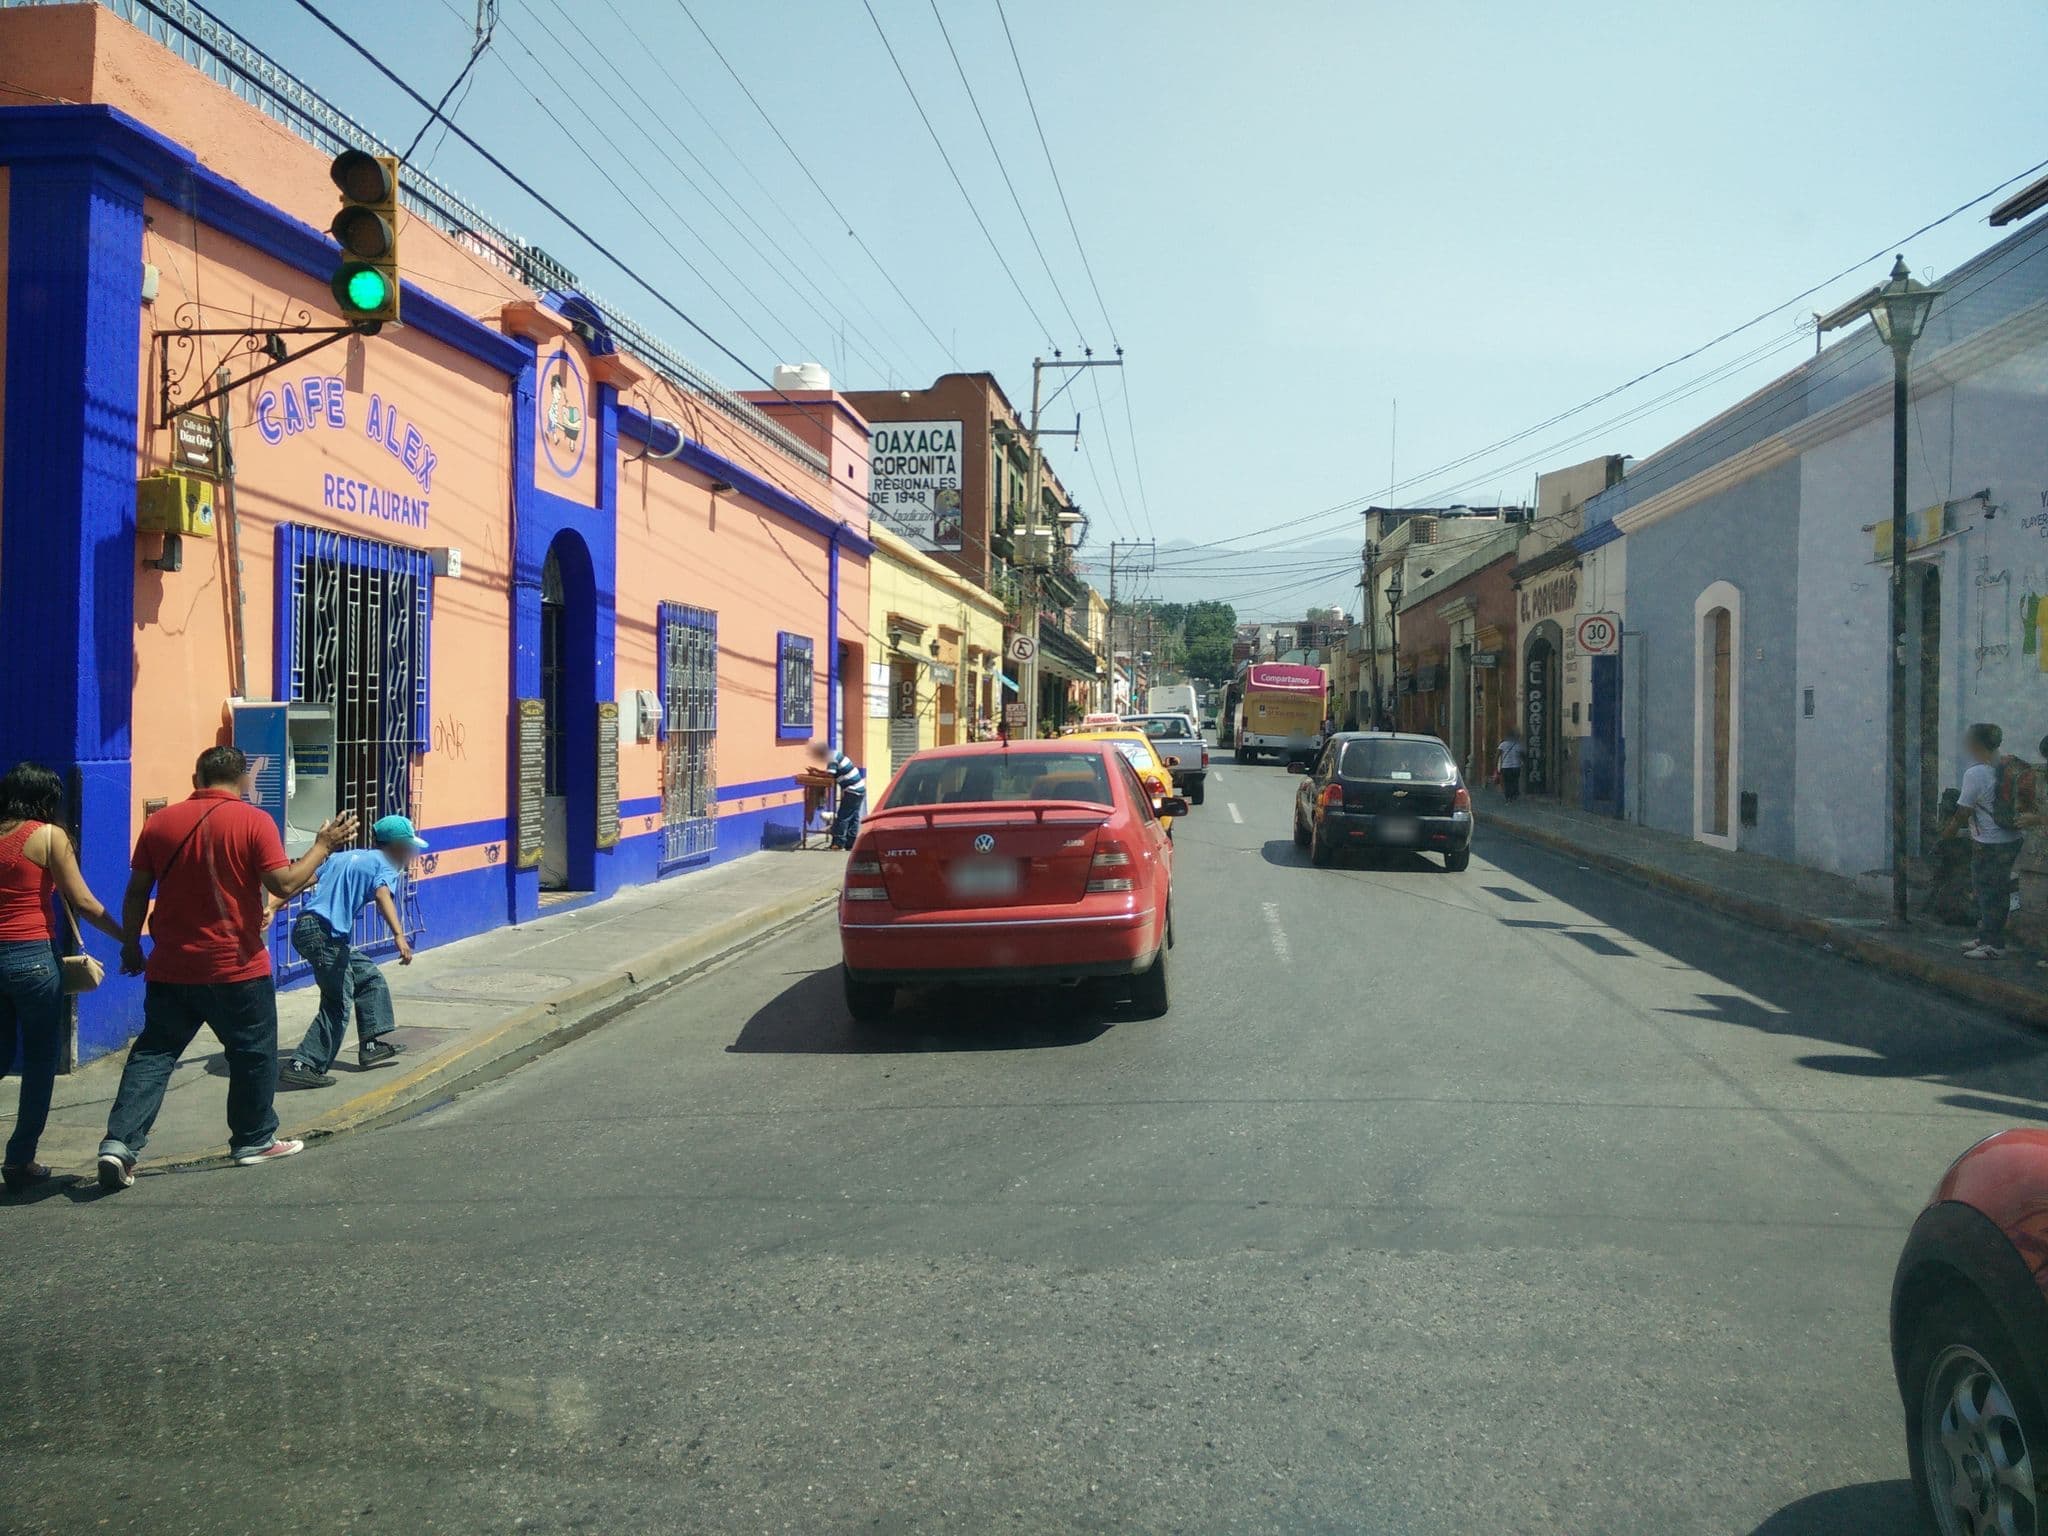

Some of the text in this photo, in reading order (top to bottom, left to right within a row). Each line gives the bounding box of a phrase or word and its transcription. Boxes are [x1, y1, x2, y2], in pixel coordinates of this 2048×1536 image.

[257, 376, 437, 494] CAFE ALEX
[875, 430, 957, 453] OAXACA
[873, 456, 957, 475] CORONITA
[874, 478, 957, 490] REGIONALES
[324, 473, 430, 530] RESTAURANT
[895, 491, 925, 504] 1948
[1587, 624, 1607, 640] 30
[1261, 674, 1309, 685] Compartamos
[885, 849, 917, 857] JETTA
